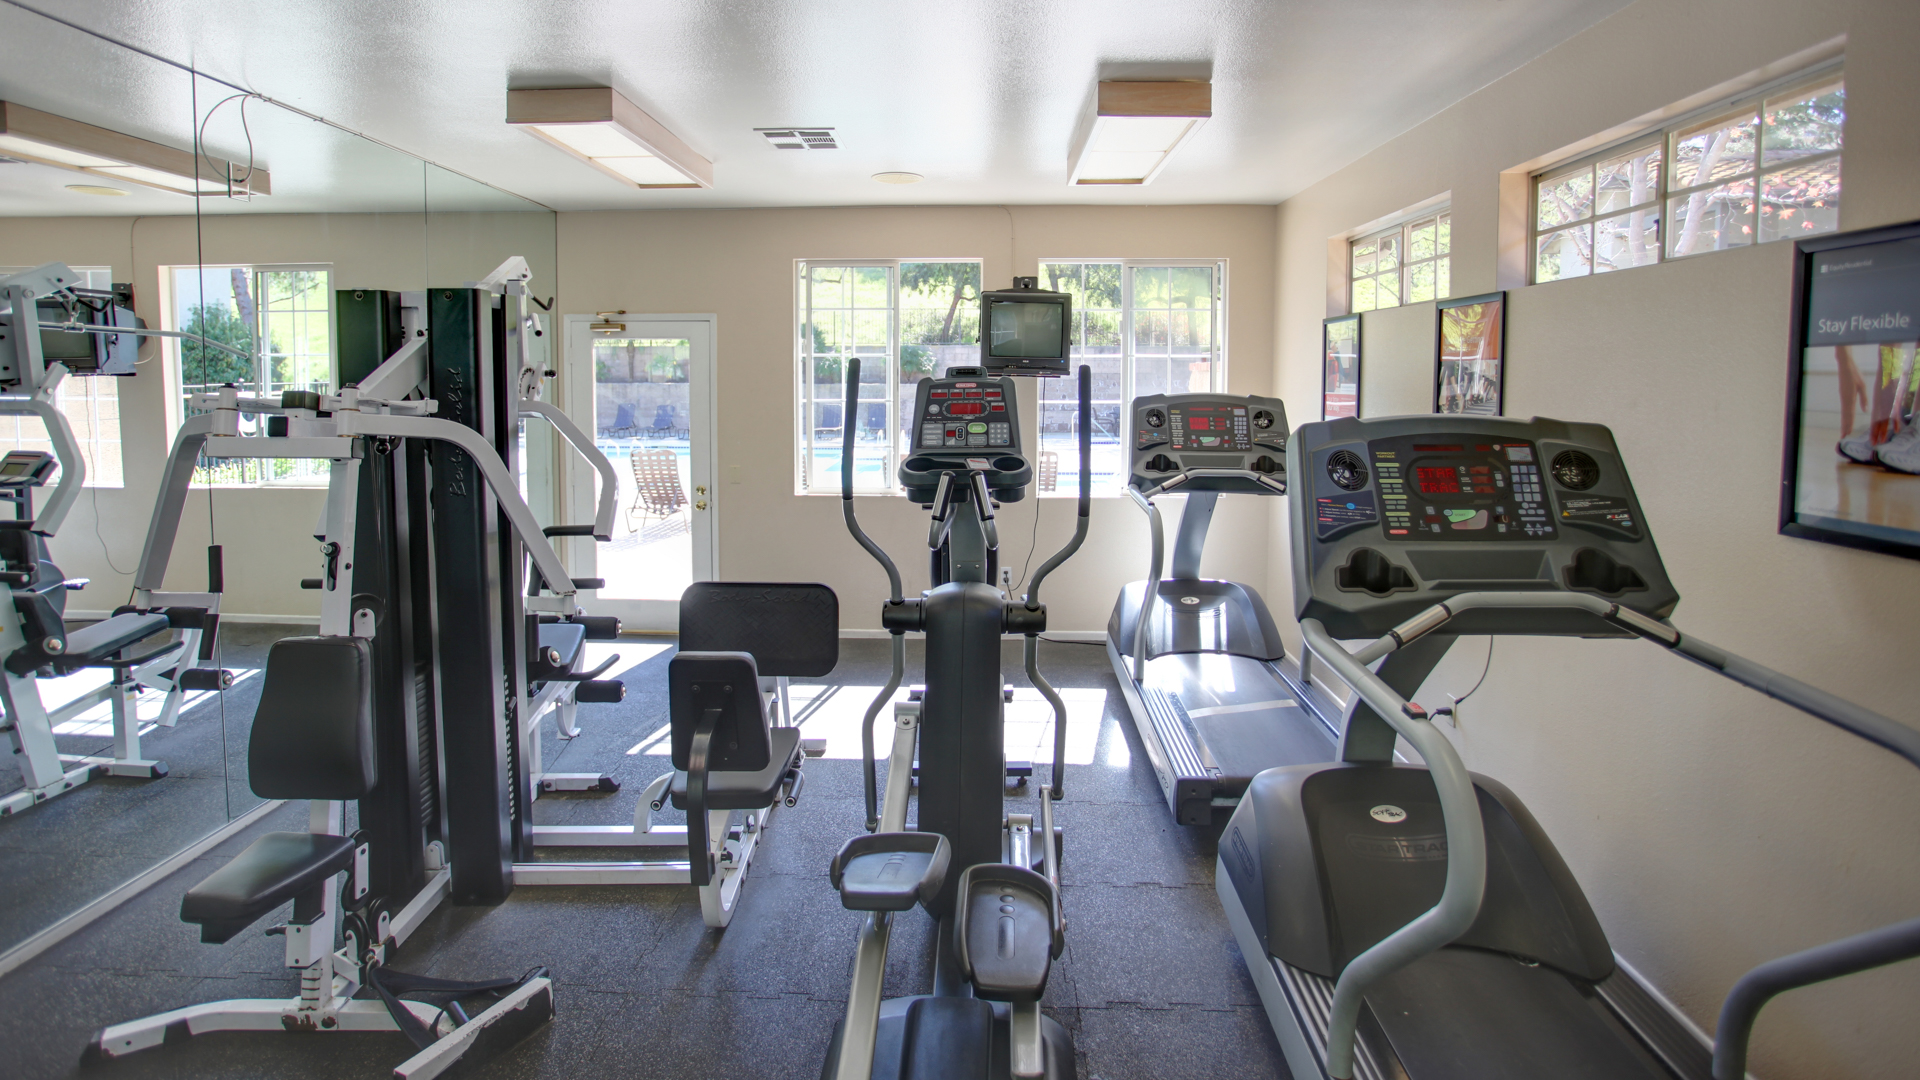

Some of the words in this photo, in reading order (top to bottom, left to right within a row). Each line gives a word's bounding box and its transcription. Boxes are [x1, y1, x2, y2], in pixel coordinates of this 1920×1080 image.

[1818, 318, 1847, 336] Stay
[1850, 311, 1910, 331] Flexible
[1416, 468, 1456, 479] STAR
[1419, 482, 1459, 493] TRAC
[707, 588, 811, 607] Body-Solid
